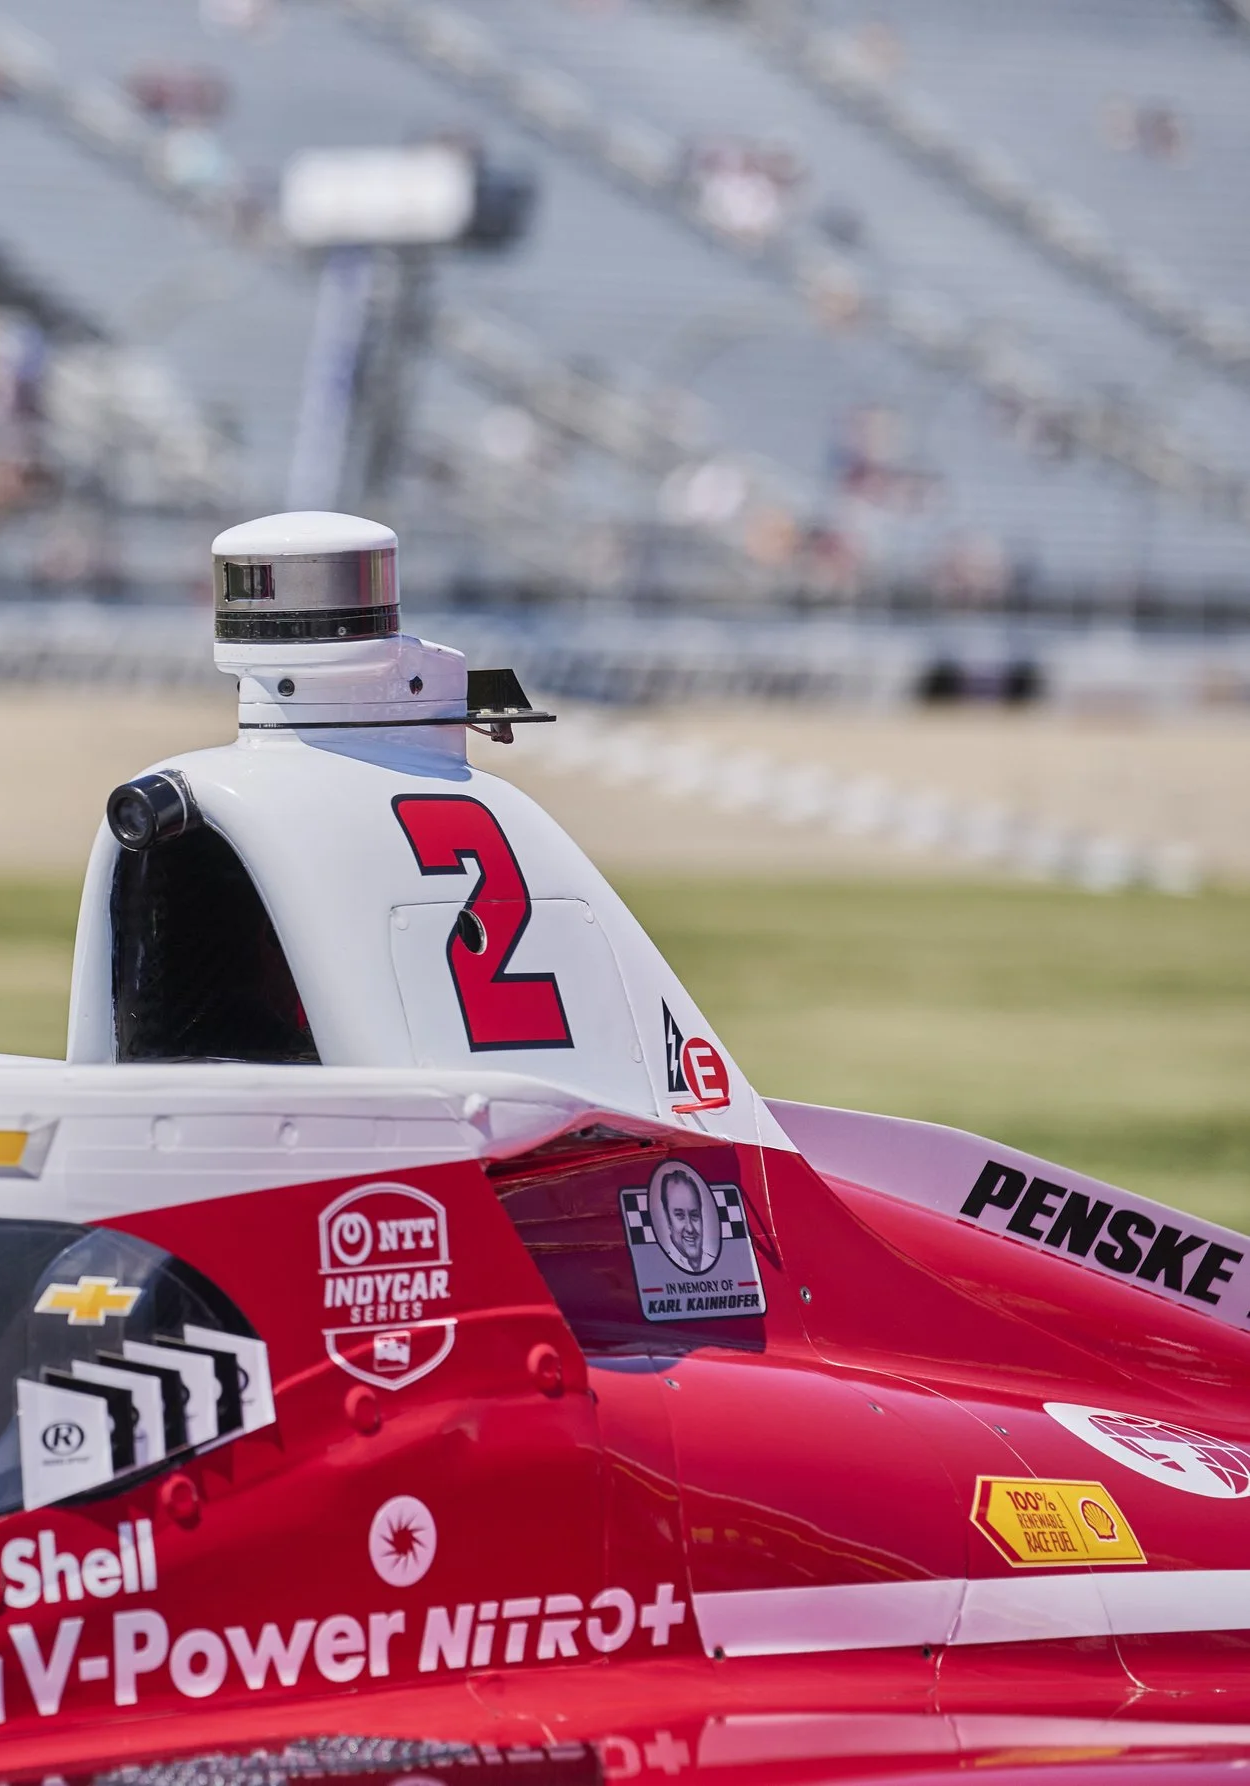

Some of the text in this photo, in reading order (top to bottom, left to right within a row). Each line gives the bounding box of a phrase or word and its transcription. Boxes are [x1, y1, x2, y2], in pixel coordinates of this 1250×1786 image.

[391, 793, 575, 1052] 2
[687, 1047, 724, 1099] E
[377, 1217, 436, 1252] NTT
[959, 1159, 1244, 1306] PENSKE
[323, 1269, 451, 1309] INDYCAR
[647, 1293, 760, 1314] KARL KAINHOFER
[666, 1279, 734, 1295] IN MEMORY OF
[350, 1301, 423, 1324] SERIES
[1006, 1491, 1056, 1512] 100%
[1016, 1513, 1066, 1529] RENEWABLE
[1024, 1530, 1078, 1553] RACE FUEL
[0, 1518, 158, 1609] Shell
[7, 1609, 405, 1717] V-Power
